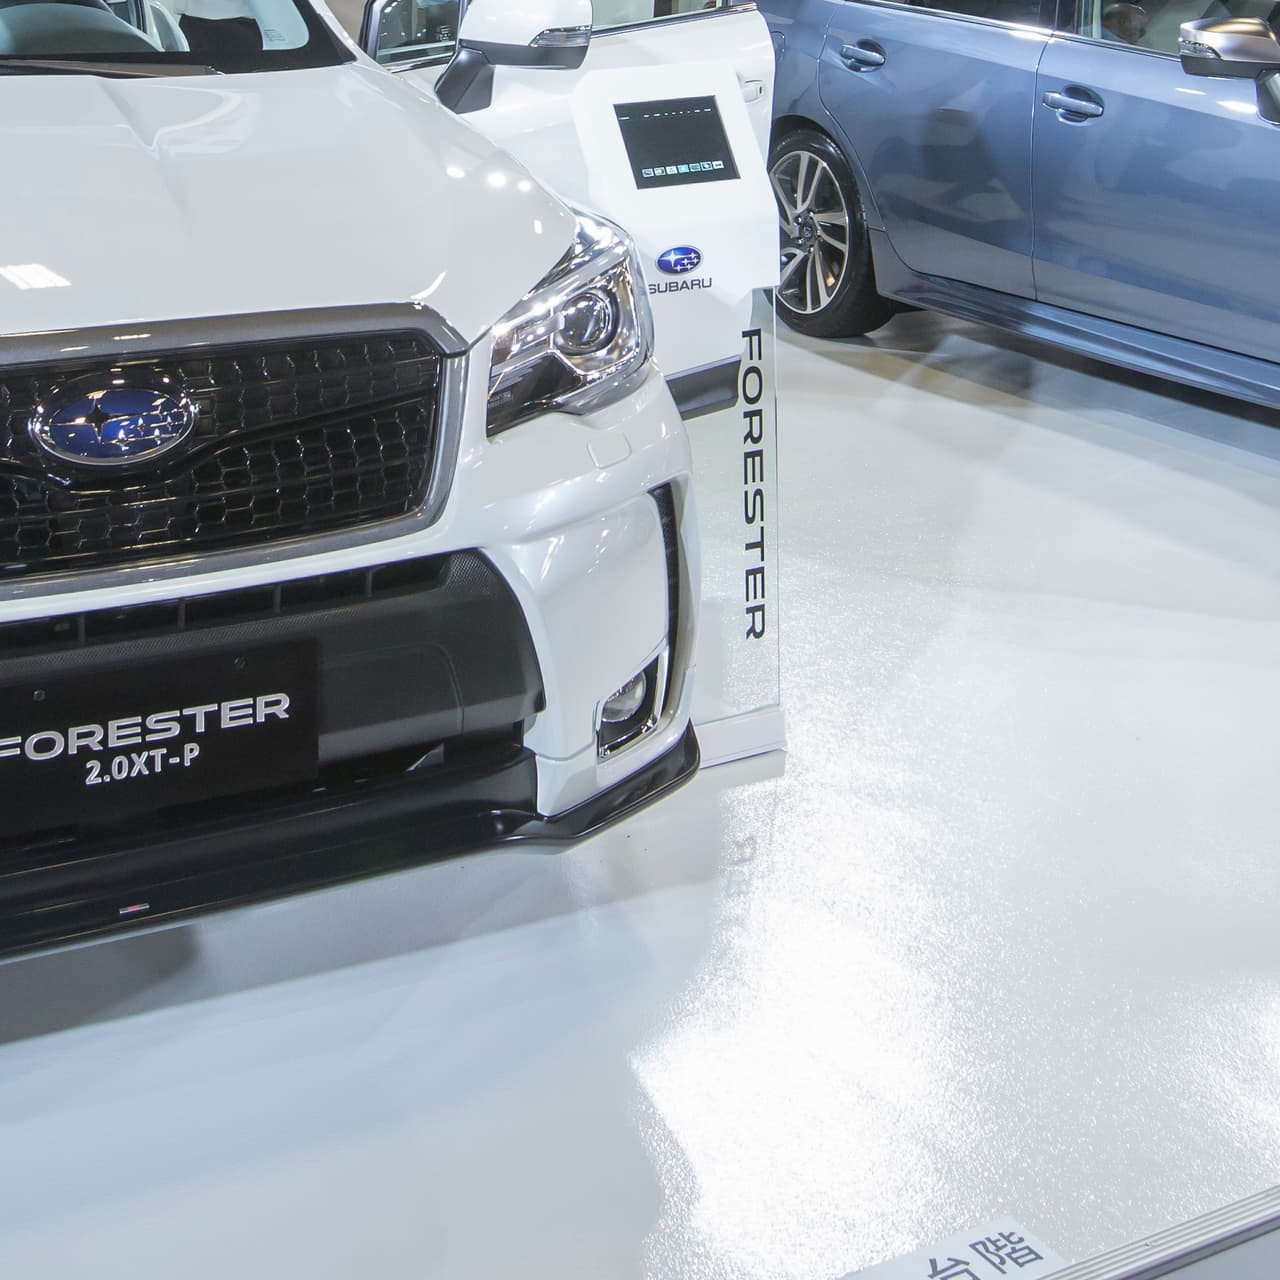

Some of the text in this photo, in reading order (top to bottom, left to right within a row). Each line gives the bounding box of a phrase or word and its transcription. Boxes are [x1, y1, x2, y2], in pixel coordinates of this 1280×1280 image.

[648, 277, 713, 295] SUBARU
[741, 327, 766, 641] FORESTER
[85, 742, 200, 785] 2.0XT-P
